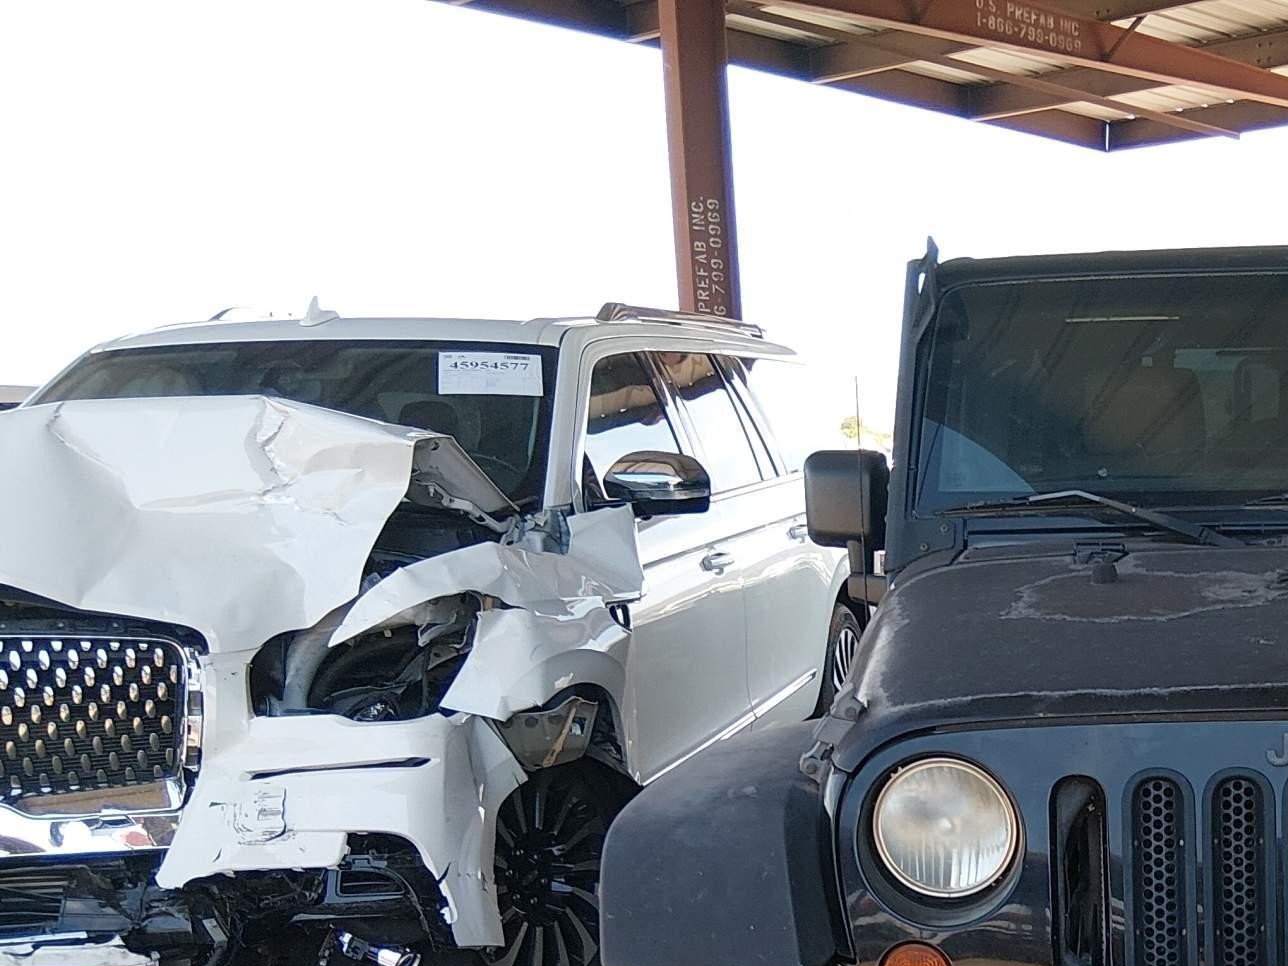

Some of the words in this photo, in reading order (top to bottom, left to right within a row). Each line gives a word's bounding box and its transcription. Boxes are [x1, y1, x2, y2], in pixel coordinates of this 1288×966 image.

[1006, 2, 1055, 30] PREFAB
[691, 195, 706, 231] INC.
[693, 240, 712, 313] PREFAB
[449, 360, 529, 371] 45954577
